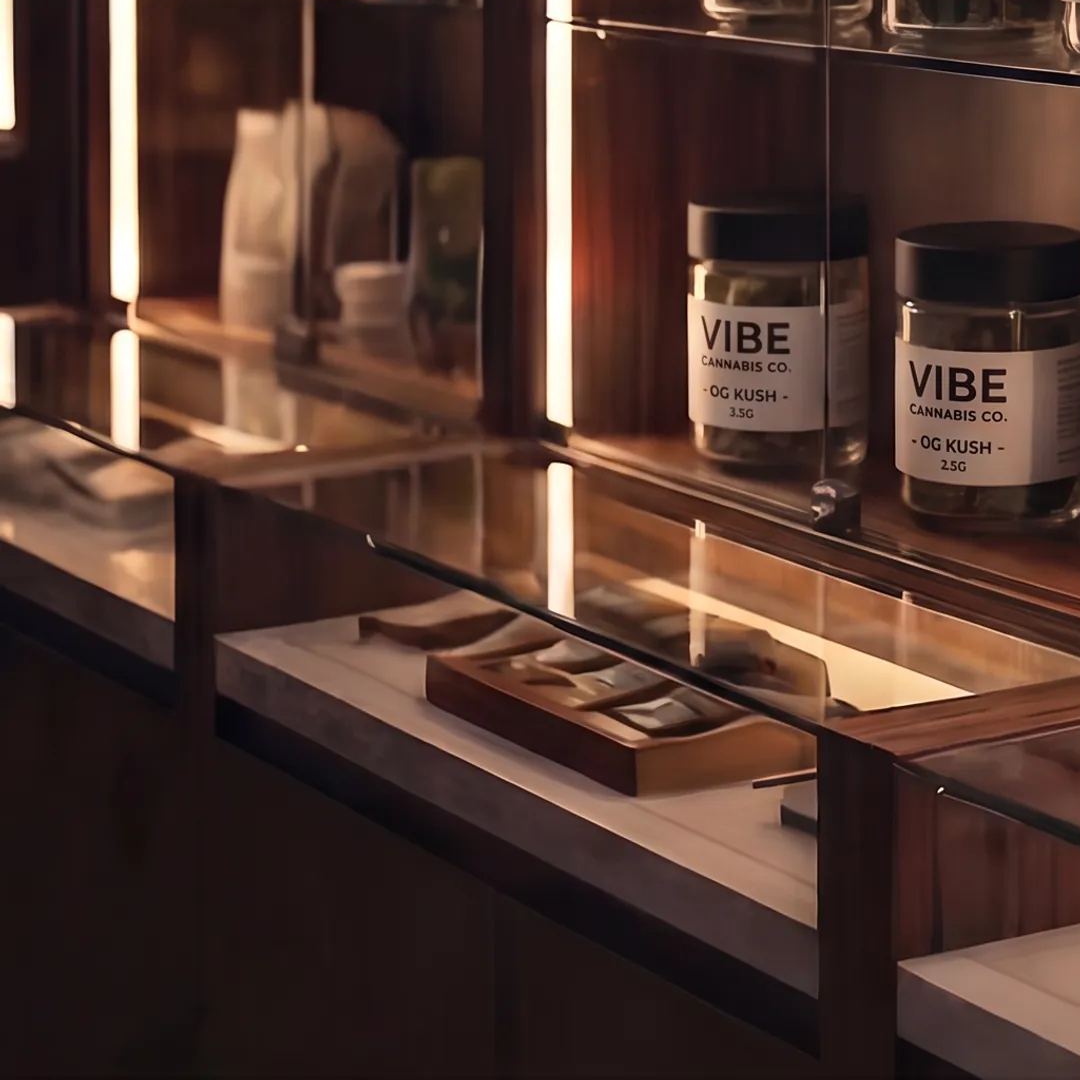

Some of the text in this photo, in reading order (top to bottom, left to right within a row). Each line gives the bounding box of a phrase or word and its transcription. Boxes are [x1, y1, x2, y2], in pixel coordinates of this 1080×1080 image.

[701, 315, 791, 355] VIBE
[702, 355, 791, 373] CANNABIS CO.
[909, 360, 1007, 404] VIBE
[710, 384, 729, 399] OG
[734, 388, 777, 402] KUSH
[730, 407, 754, 419] 3.5G
[909, 403, 1008, 423] CANNABIS CO.
[920, 435, 941, 452] OG
[946, 438, 992, 455] KUSH
